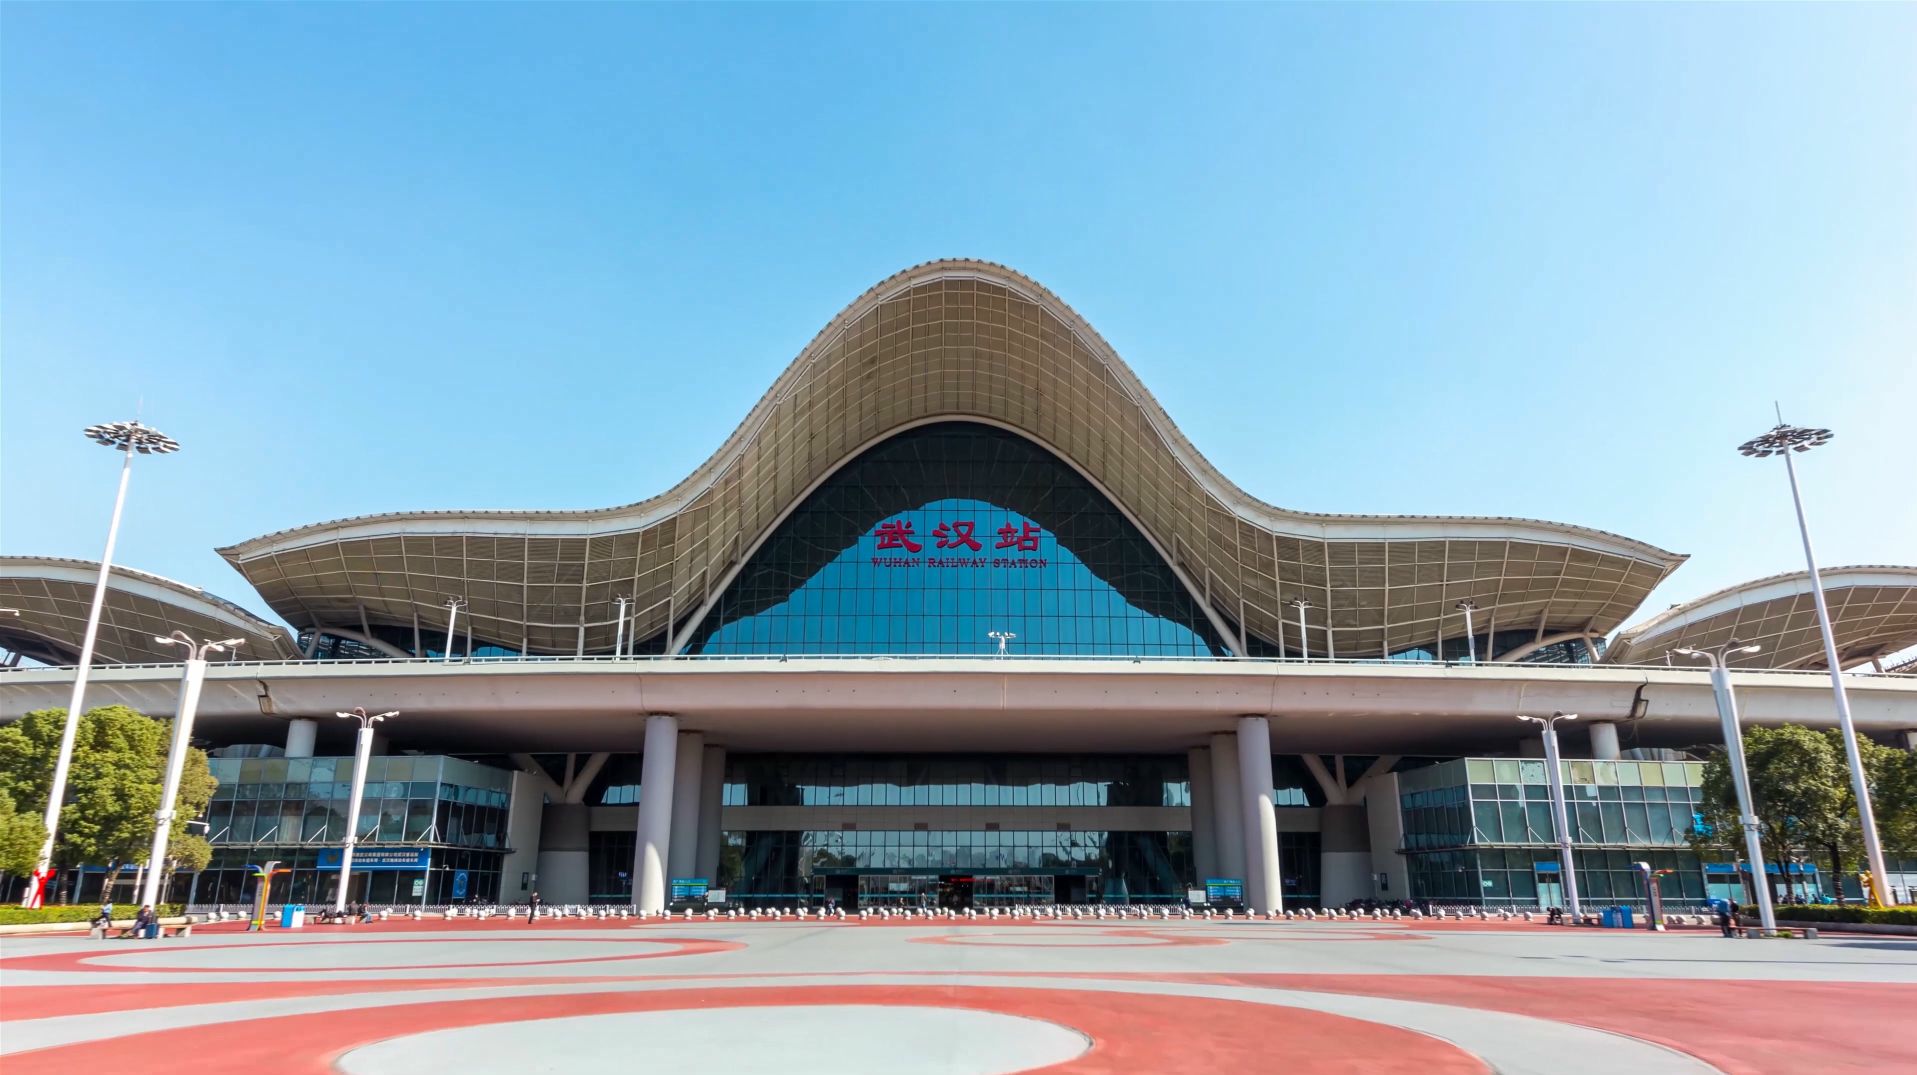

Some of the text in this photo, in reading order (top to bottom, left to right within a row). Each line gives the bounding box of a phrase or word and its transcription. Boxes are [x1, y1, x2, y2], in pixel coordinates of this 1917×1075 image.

[875, 520, 1041, 553] 武汉站
[872, 557, 1048, 569] WUHAN RAILWAY STATION
